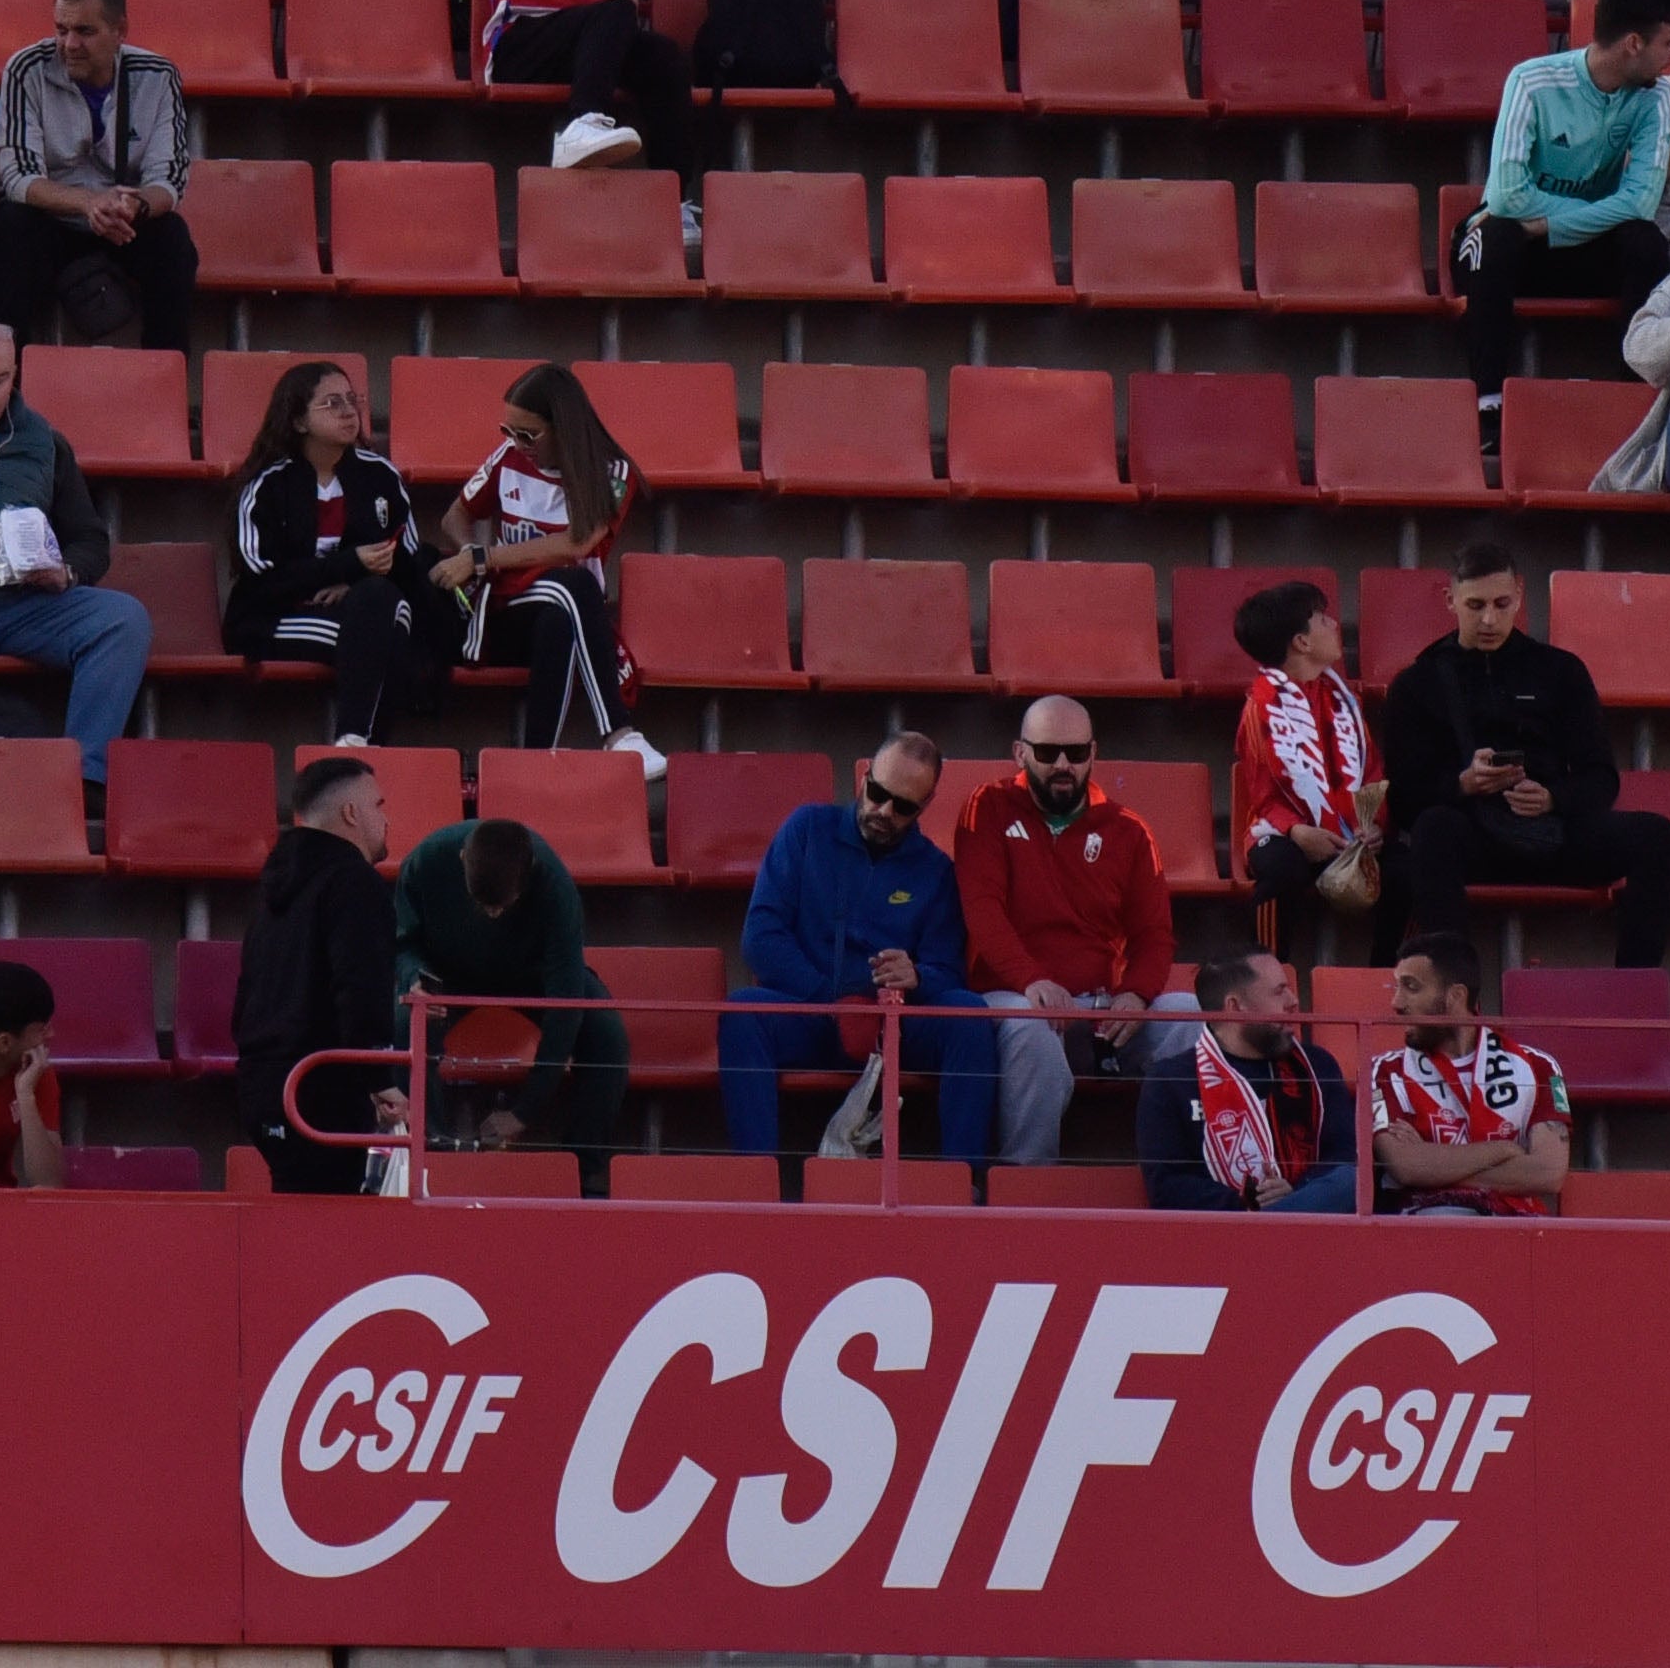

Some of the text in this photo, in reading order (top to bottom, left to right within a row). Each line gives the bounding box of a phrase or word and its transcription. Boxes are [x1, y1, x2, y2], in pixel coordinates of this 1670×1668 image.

[299, 1367, 523, 1474] CSIF
[554, 1272, 1230, 1591] CSIF
[1308, 1385, 1532, 1493] CSIF
